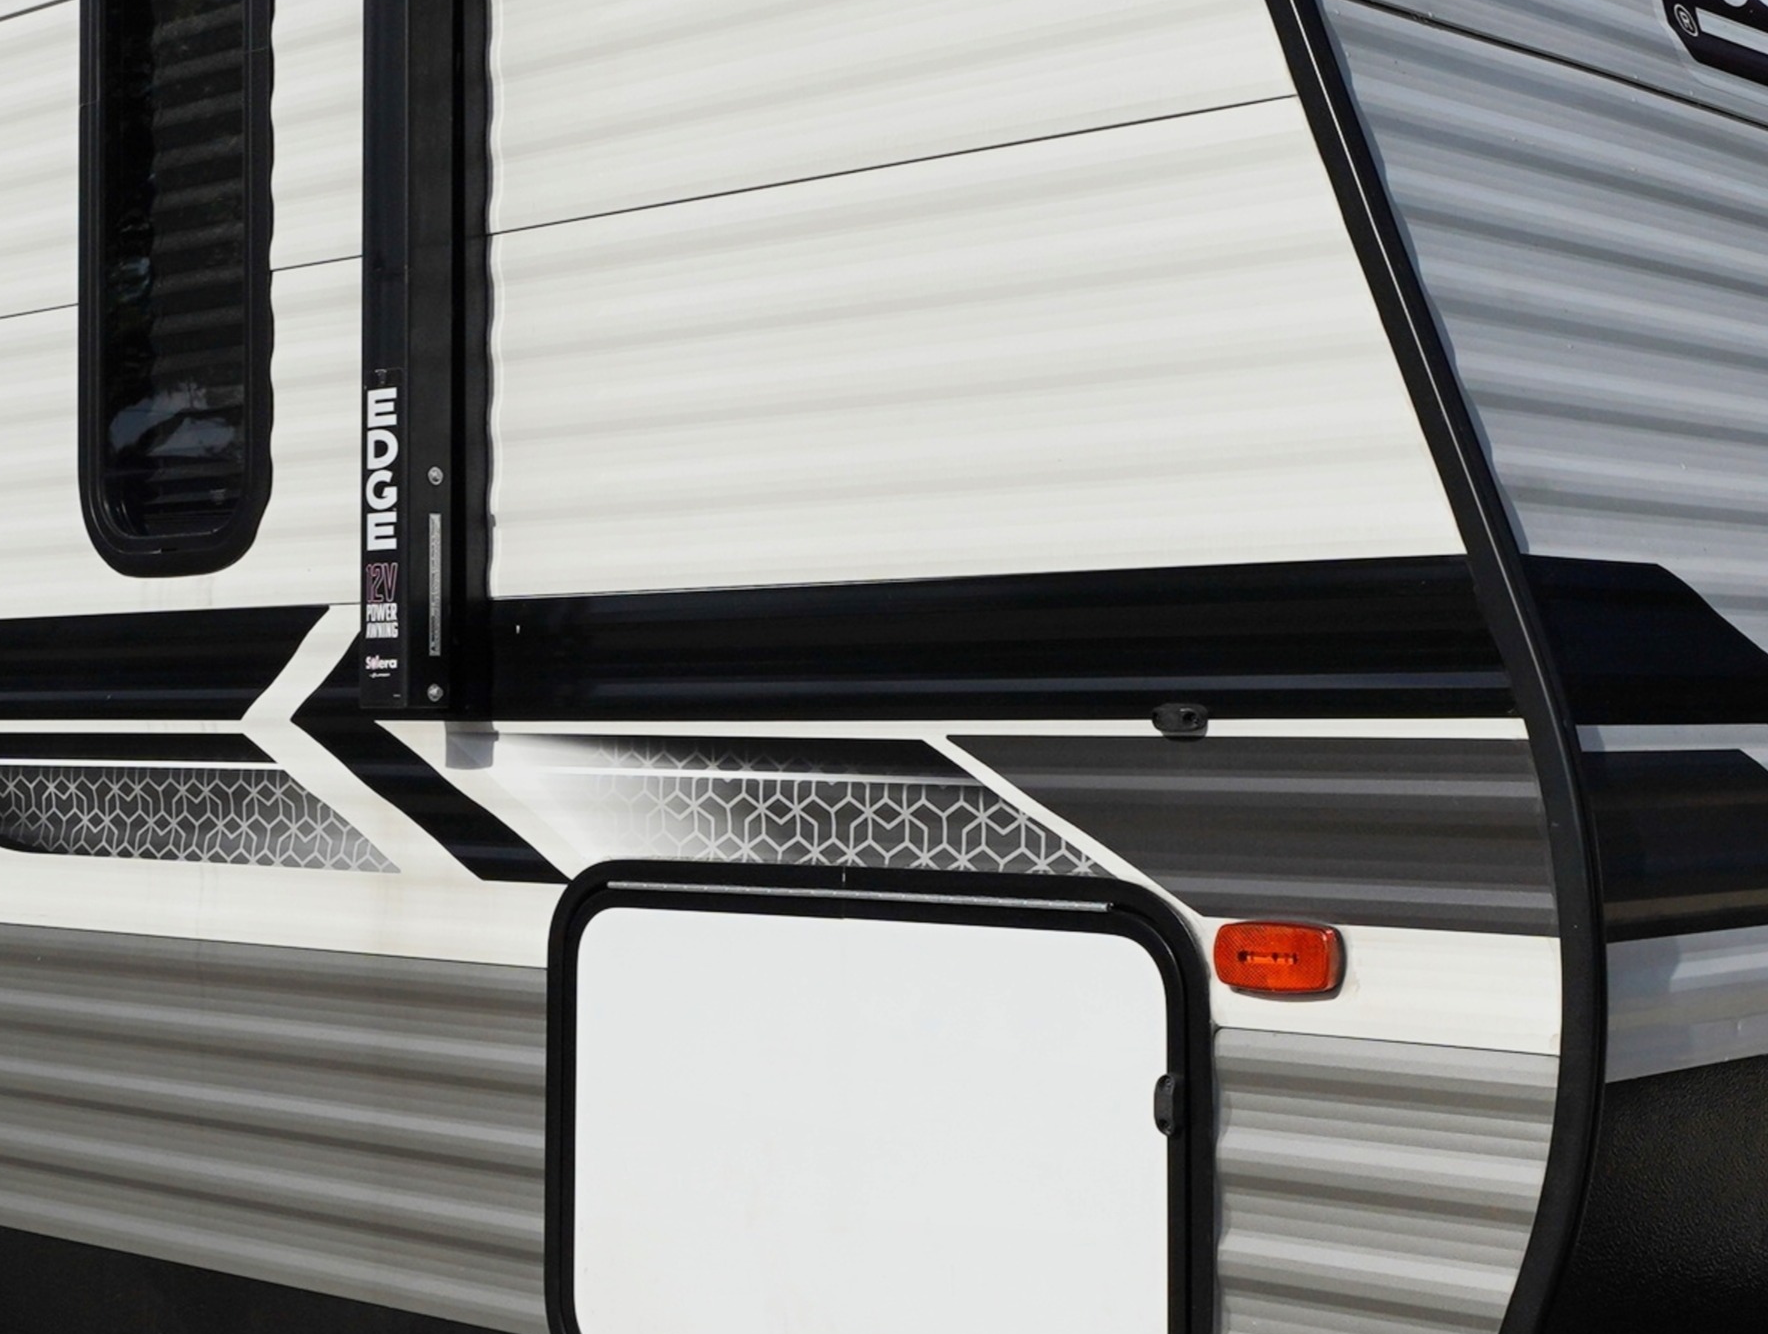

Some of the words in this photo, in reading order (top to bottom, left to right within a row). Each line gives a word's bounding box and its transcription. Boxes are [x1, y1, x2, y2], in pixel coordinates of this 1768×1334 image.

[366, 387, 398, 551] EDGE
[366, 562, 398, 603] 12V
[366, 603, 397, 622] POWER
